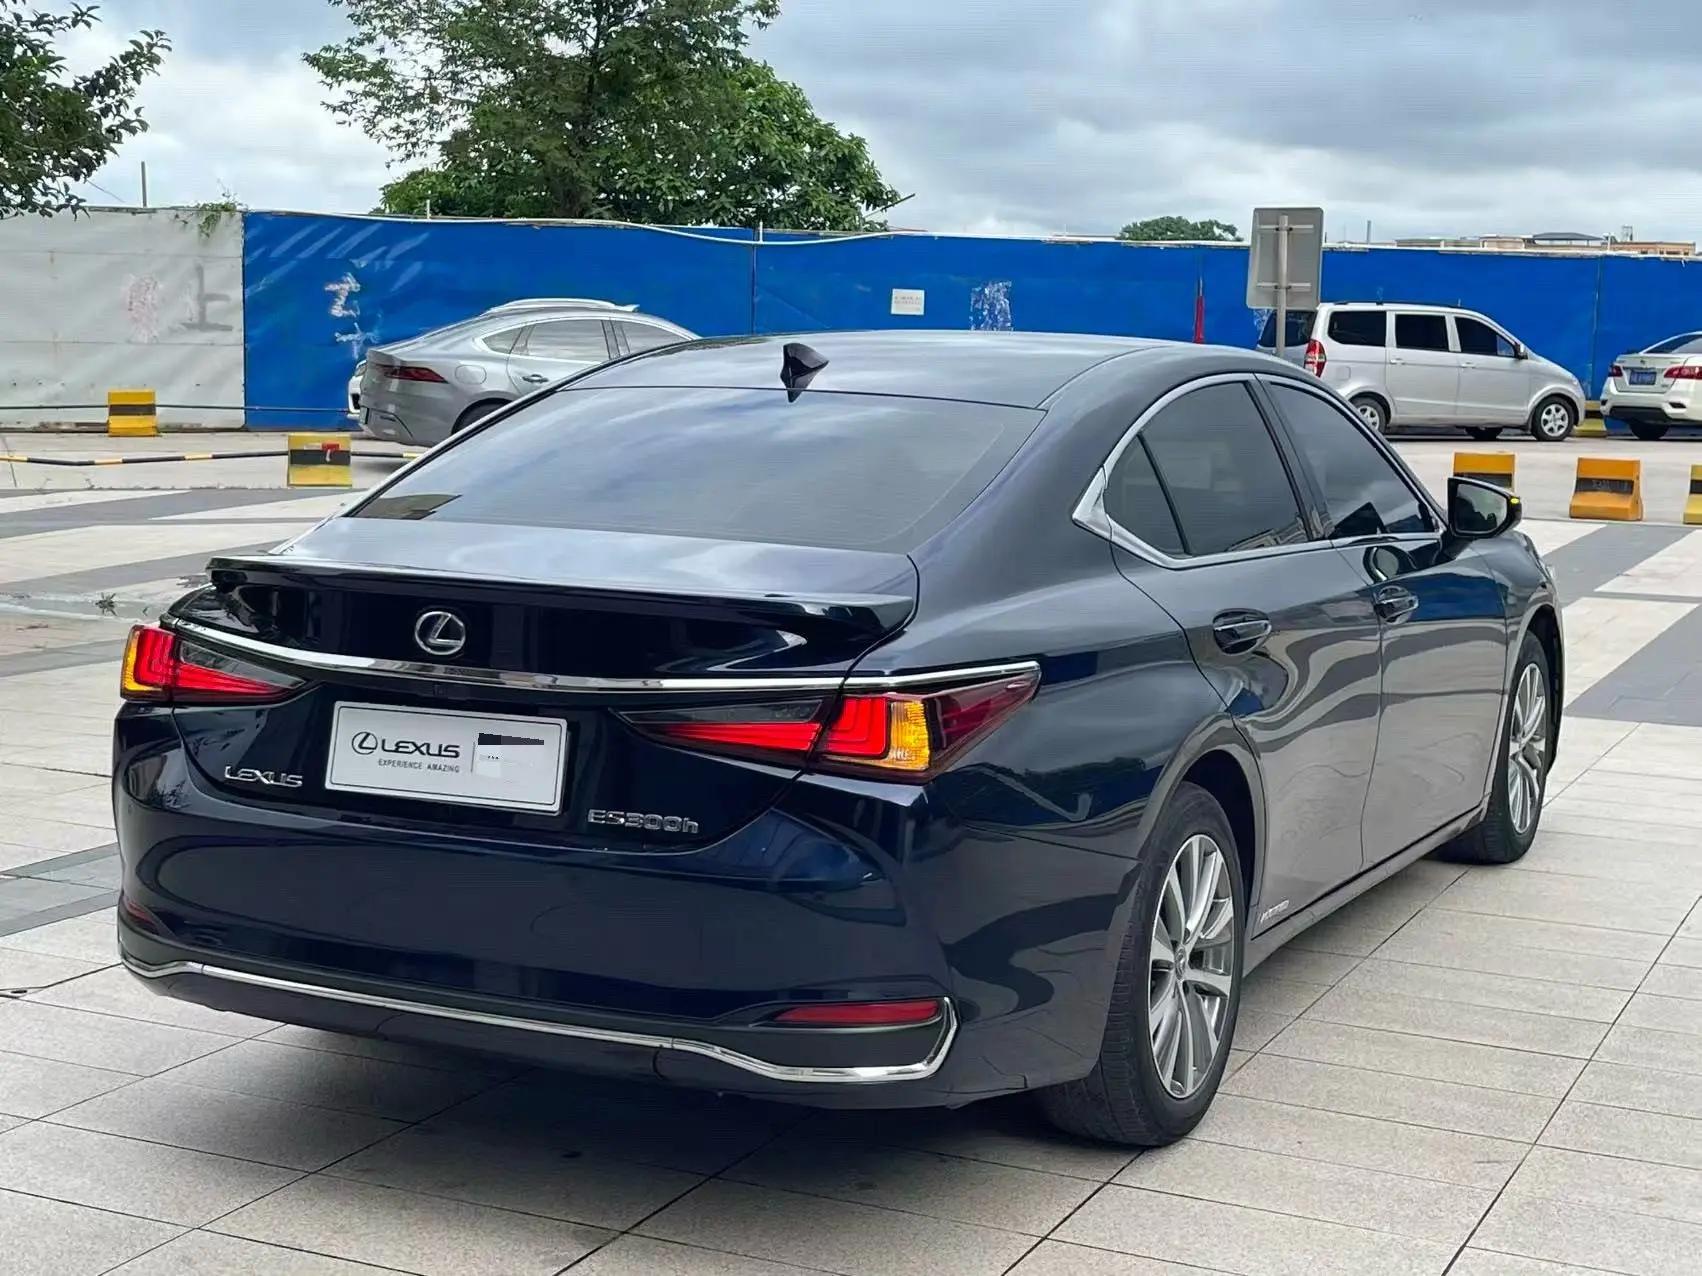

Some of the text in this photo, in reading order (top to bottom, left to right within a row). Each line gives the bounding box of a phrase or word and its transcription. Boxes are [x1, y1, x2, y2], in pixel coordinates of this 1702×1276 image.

[381, 738, 460, 759] LEXUS
[224, 765, 303, 788] LEXUS
[378, 758, 460, 773] EXPERIENCE AMAZING
[587, 808, 699, 834] ES300h
